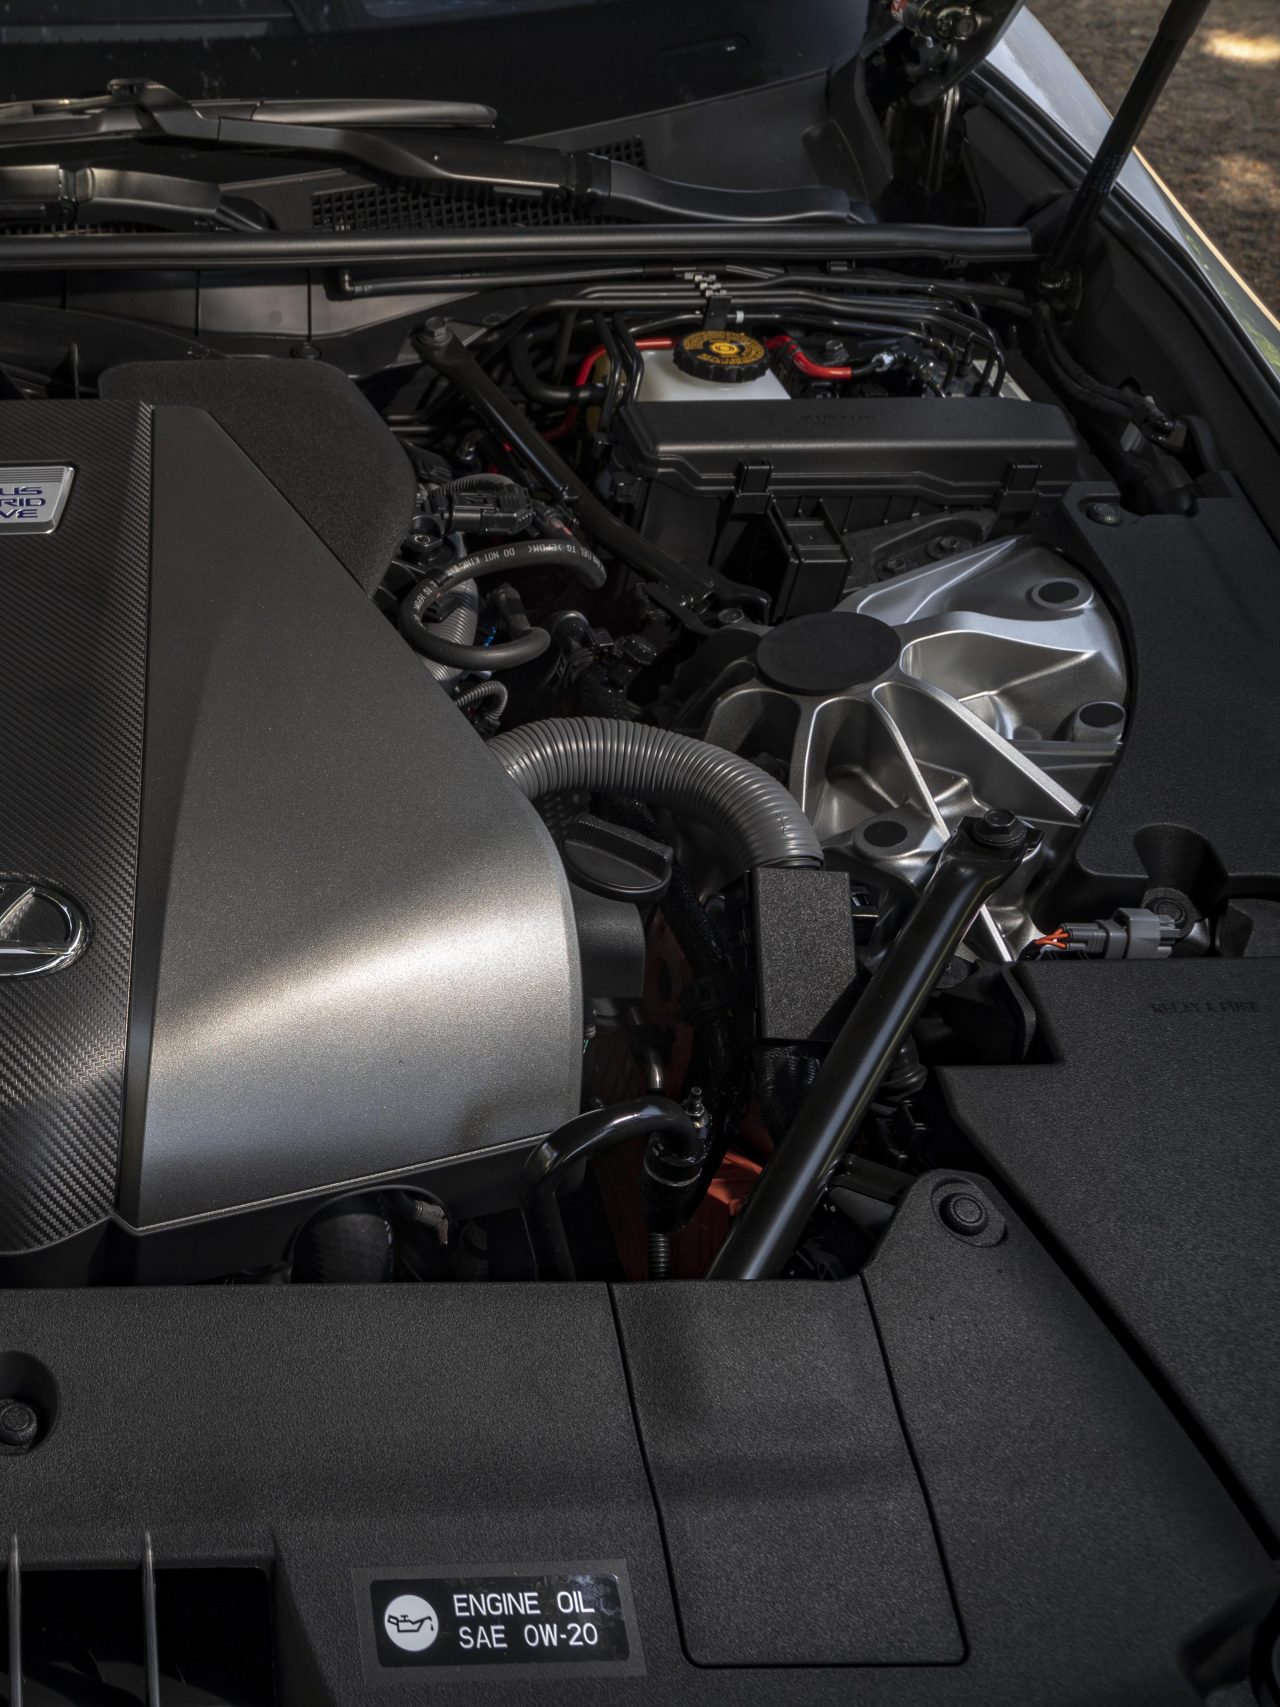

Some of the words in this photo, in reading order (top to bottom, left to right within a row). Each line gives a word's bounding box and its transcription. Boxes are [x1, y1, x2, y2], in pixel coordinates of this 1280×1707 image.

[484, 550, 500, 562] NOT
[503, 547, 516, 558] DO
[453, 1592, 541, 1617] ENGINE
[556, 1591, 595, 1613] OIL
[459, 1624, 508, 1649] SAE
[524, 1622, 598, 1647] 0W-20
